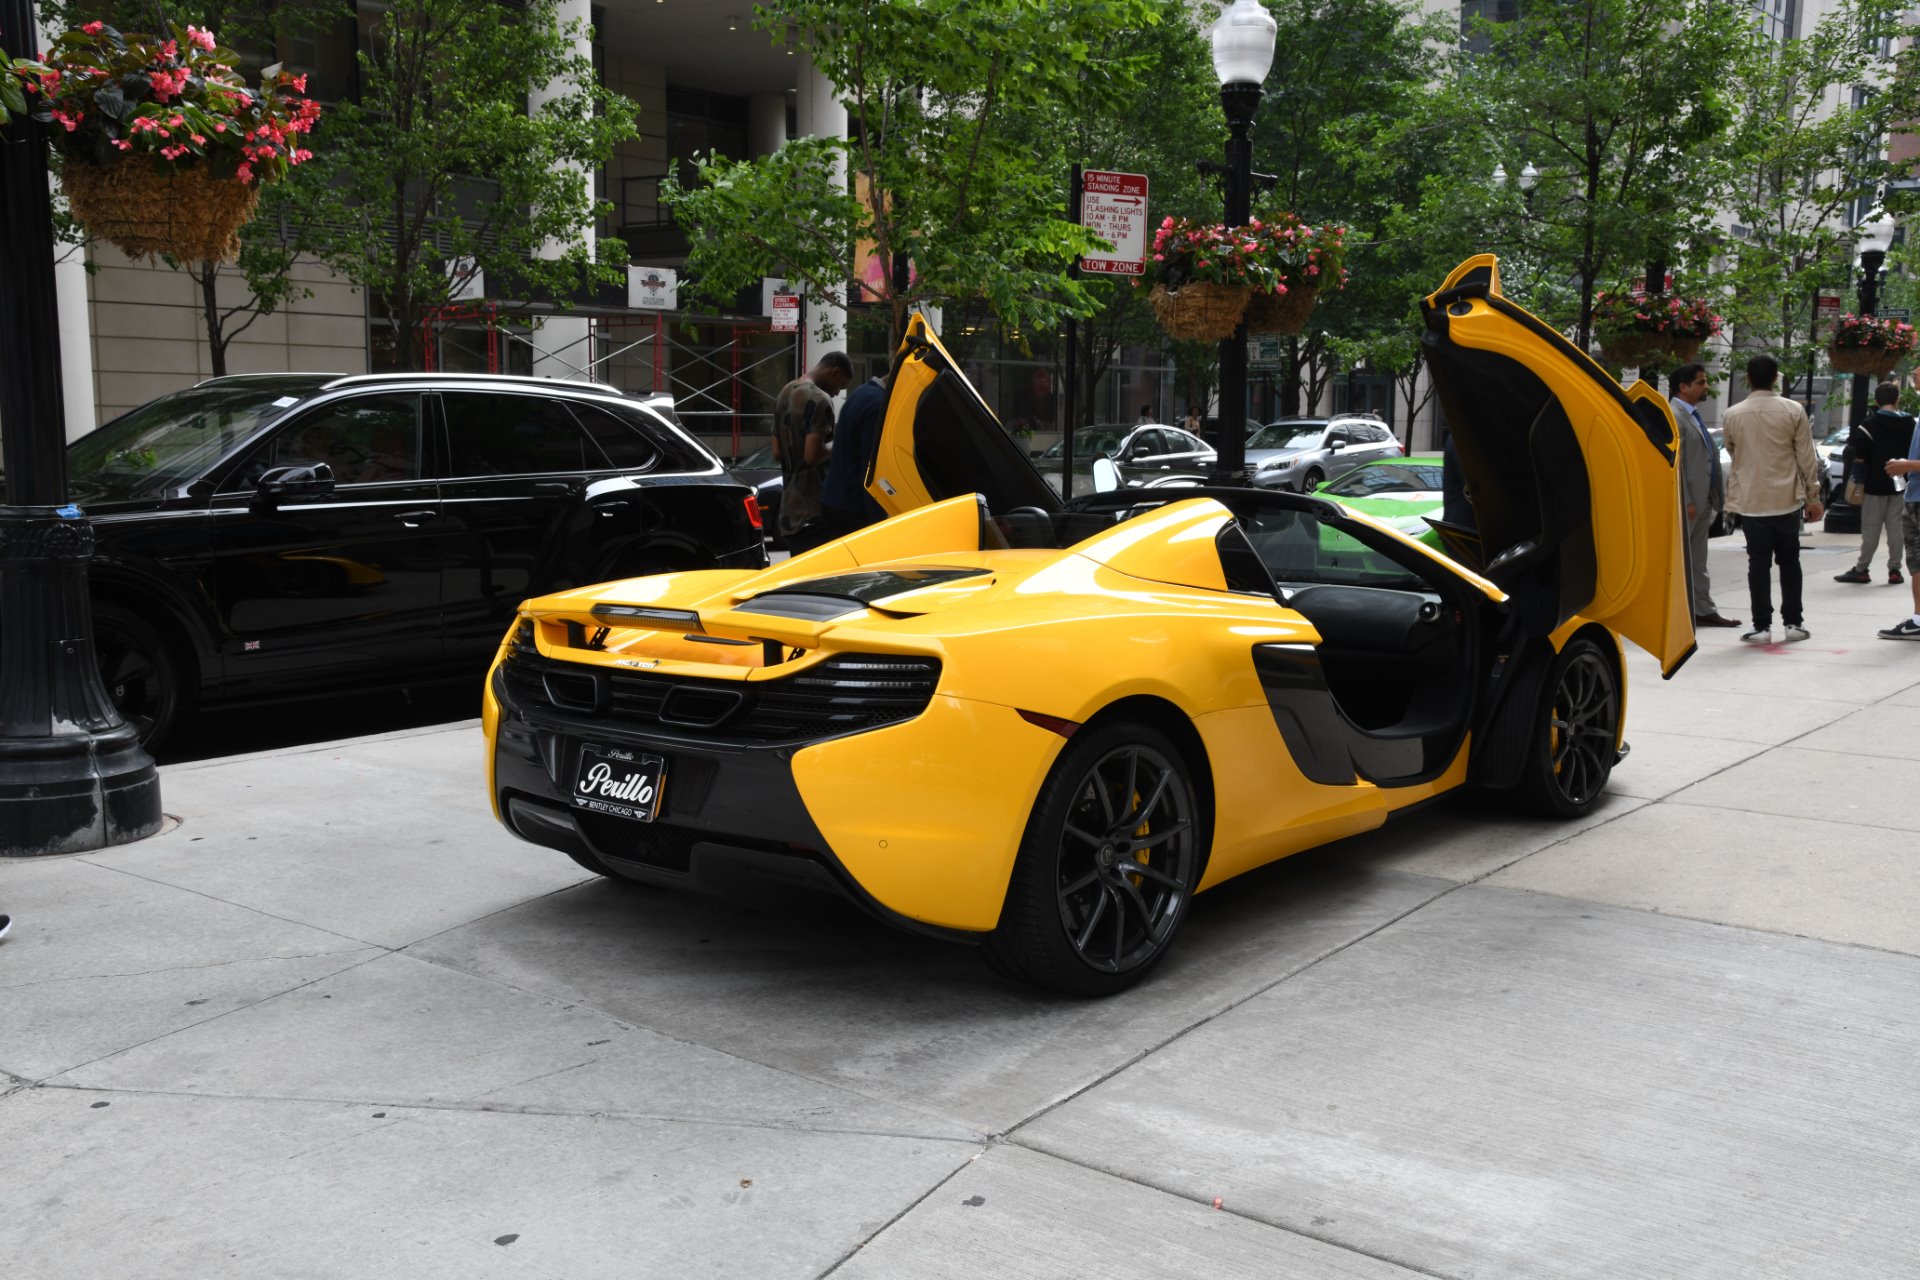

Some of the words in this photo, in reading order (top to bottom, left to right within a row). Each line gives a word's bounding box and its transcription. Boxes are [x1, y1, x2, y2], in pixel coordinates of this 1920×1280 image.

[1096, 175, 1121, 184] MINUTE
[1087, 183, 1120, 193] STANDING
[1123, 186, 1140, 194] ZONE
[1086, 196, 1100, 204] USE
[1086, 205, 1119, 214] FLASHING
[1121, 208, 1143, 216] LIGHTS
[1086, 221, 1101, 229] MON
[1109, 223, 1132, 231] THURS
[1086, 260, 1106, 270] TOW
[1112, 263, 1139, 273] ZONE
[608, 749, 634, 760] Perillo
[580, 762, 653, 804] Perillo
[588, 801, 609, 811] BENTLEY
[608, 805, 633, 816] CHICAGO
